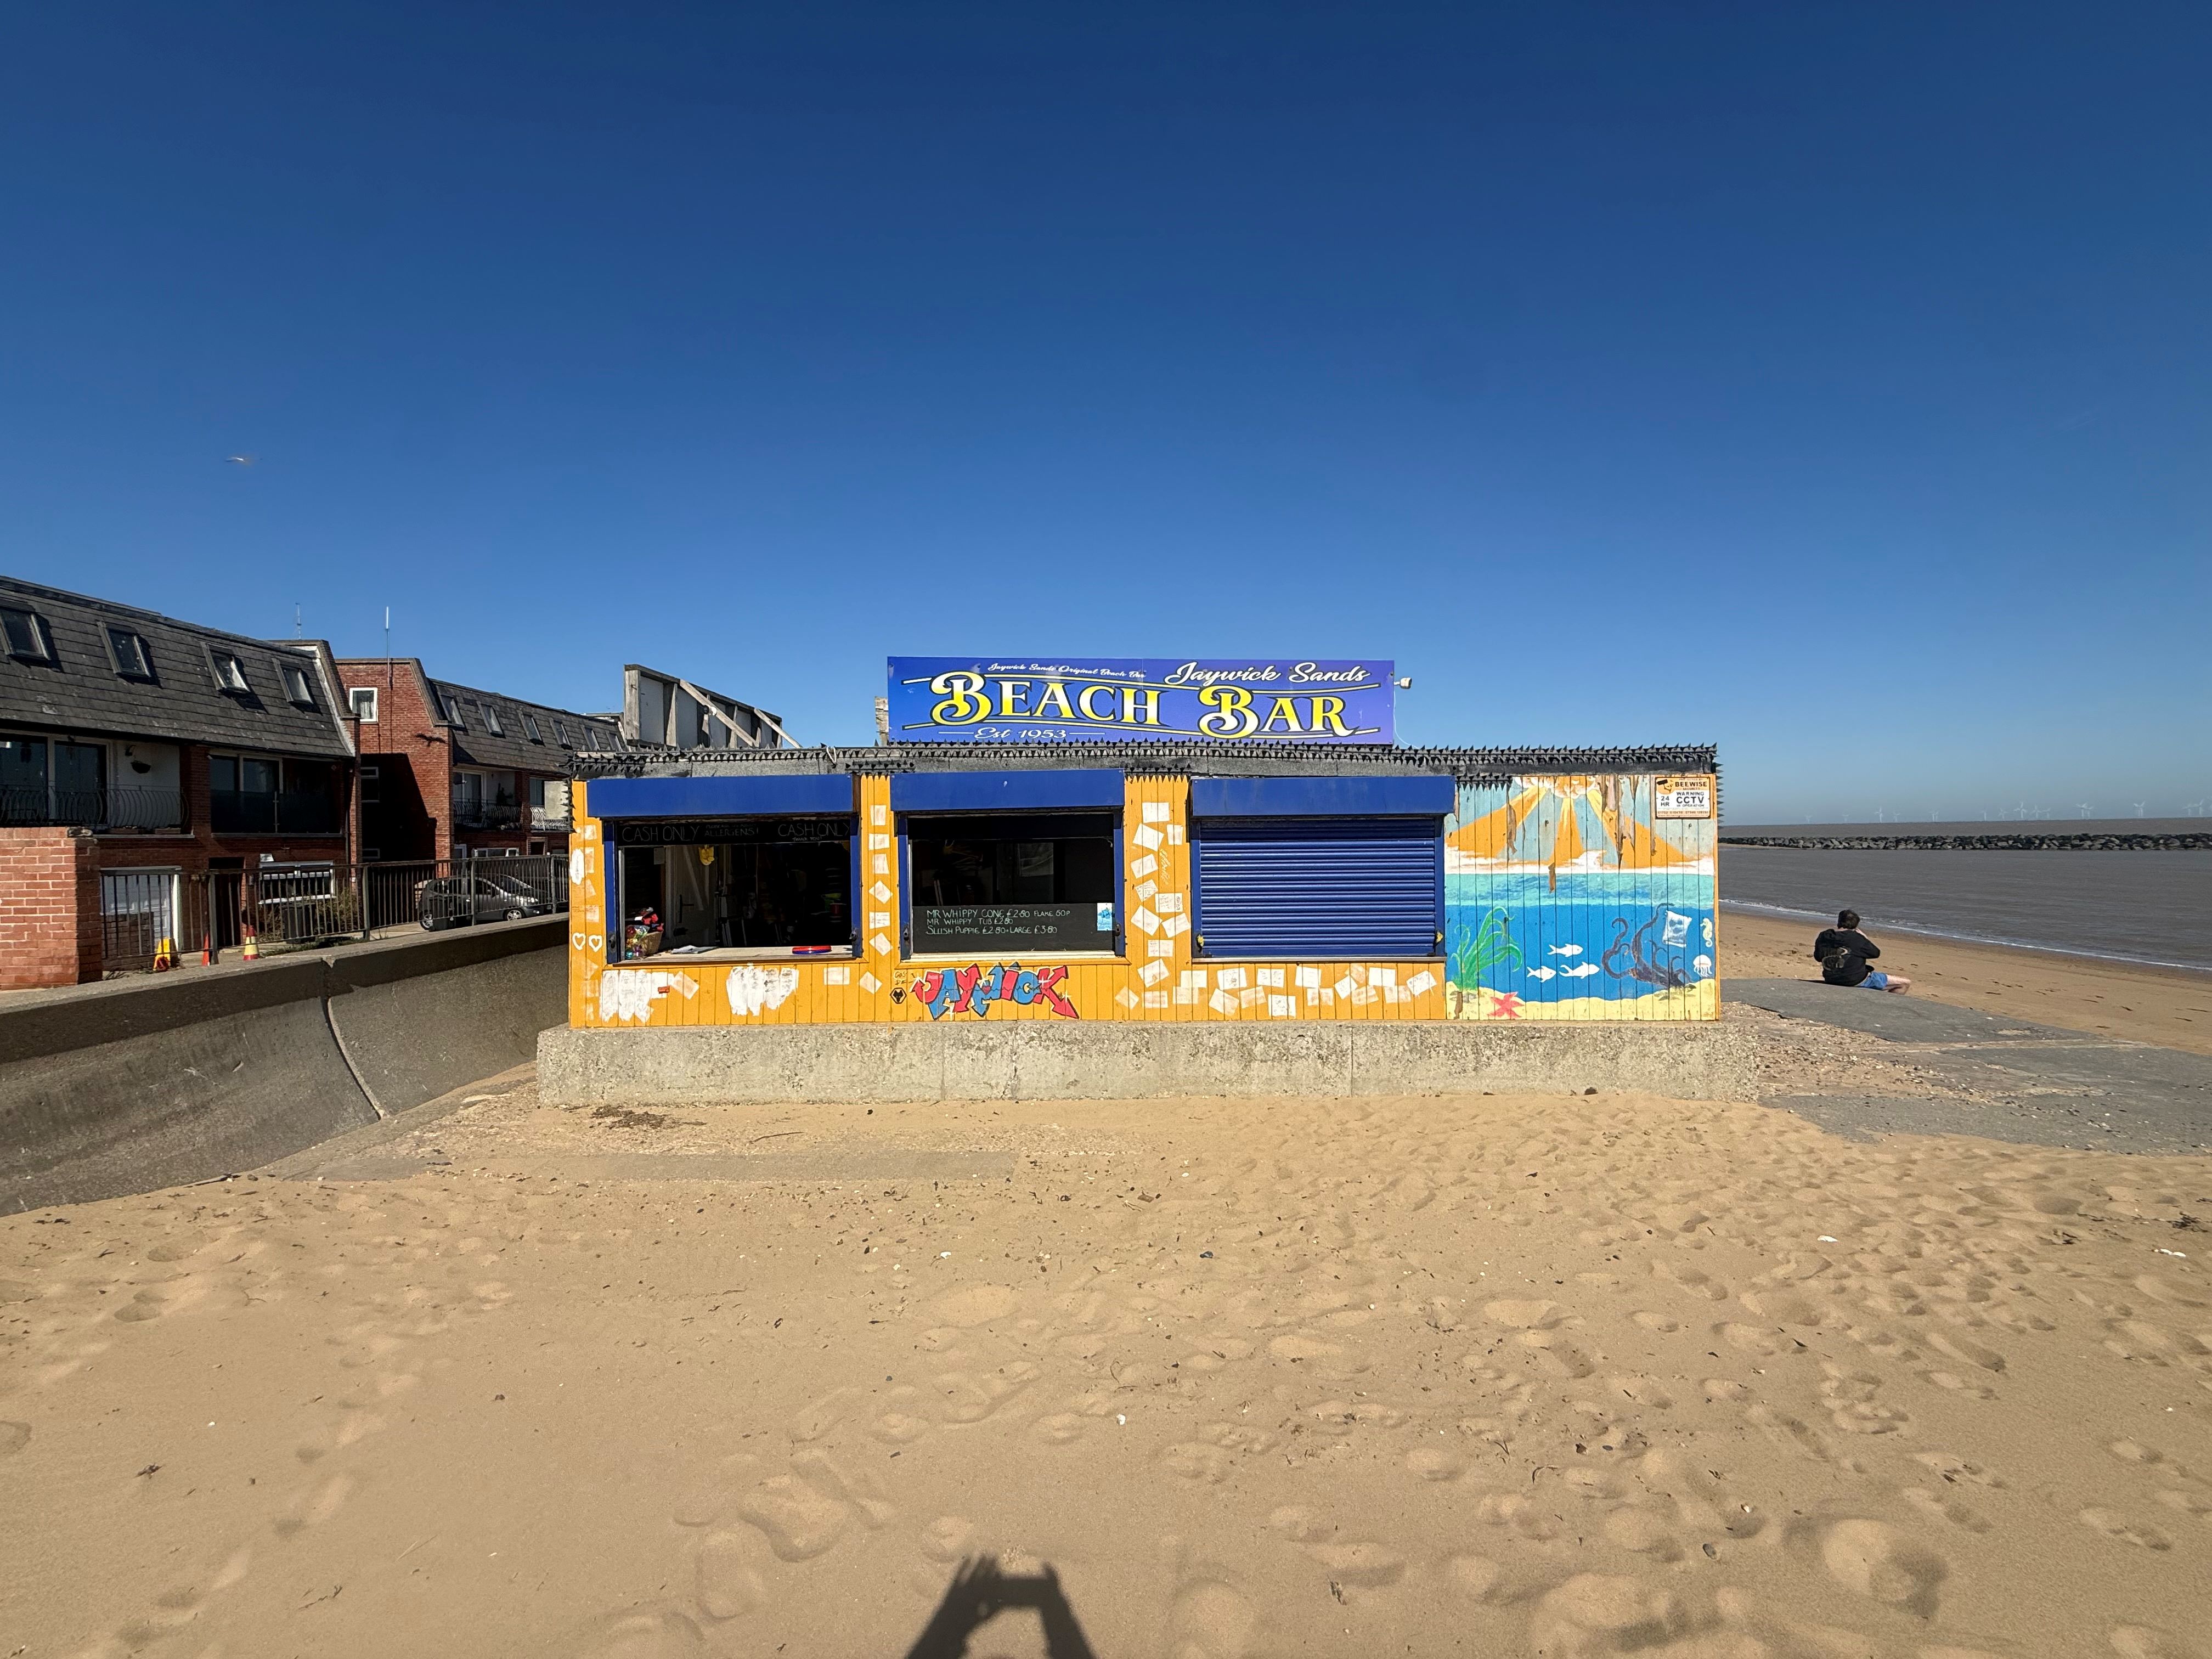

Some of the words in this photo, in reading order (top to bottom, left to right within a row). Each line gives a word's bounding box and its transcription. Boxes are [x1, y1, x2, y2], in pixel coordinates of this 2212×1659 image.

[988, 663, 1026, 672] Jaywick
[1029, 663, 1057, 672] Sands
[1058, 665, 1099, 675] Original
[1100, 668, 1127, 676] Beach
[1164, 661, 1282, 686] Jaywick
[1288, 662, 1371, 683] Sands
[930, 670, 1169, 726] BEACH
[1198, 684, 1358, 739] BAR
[974, 727, 1014, 739] Est
[1018, 729, 1066, 739] 1953
[622, 826, 658, 842] CASH
[663, 825, 699, 842] ONLY
[777, 823, 814, 837] CASH
[817, 822, 850, 837] ONLY
[927, 909, 941, 918] MR
[981, 909, 1005, 918] CONE
[926, 924, 953, 934] SLUSH
[1009, 926, 1032, 934] LARGE
